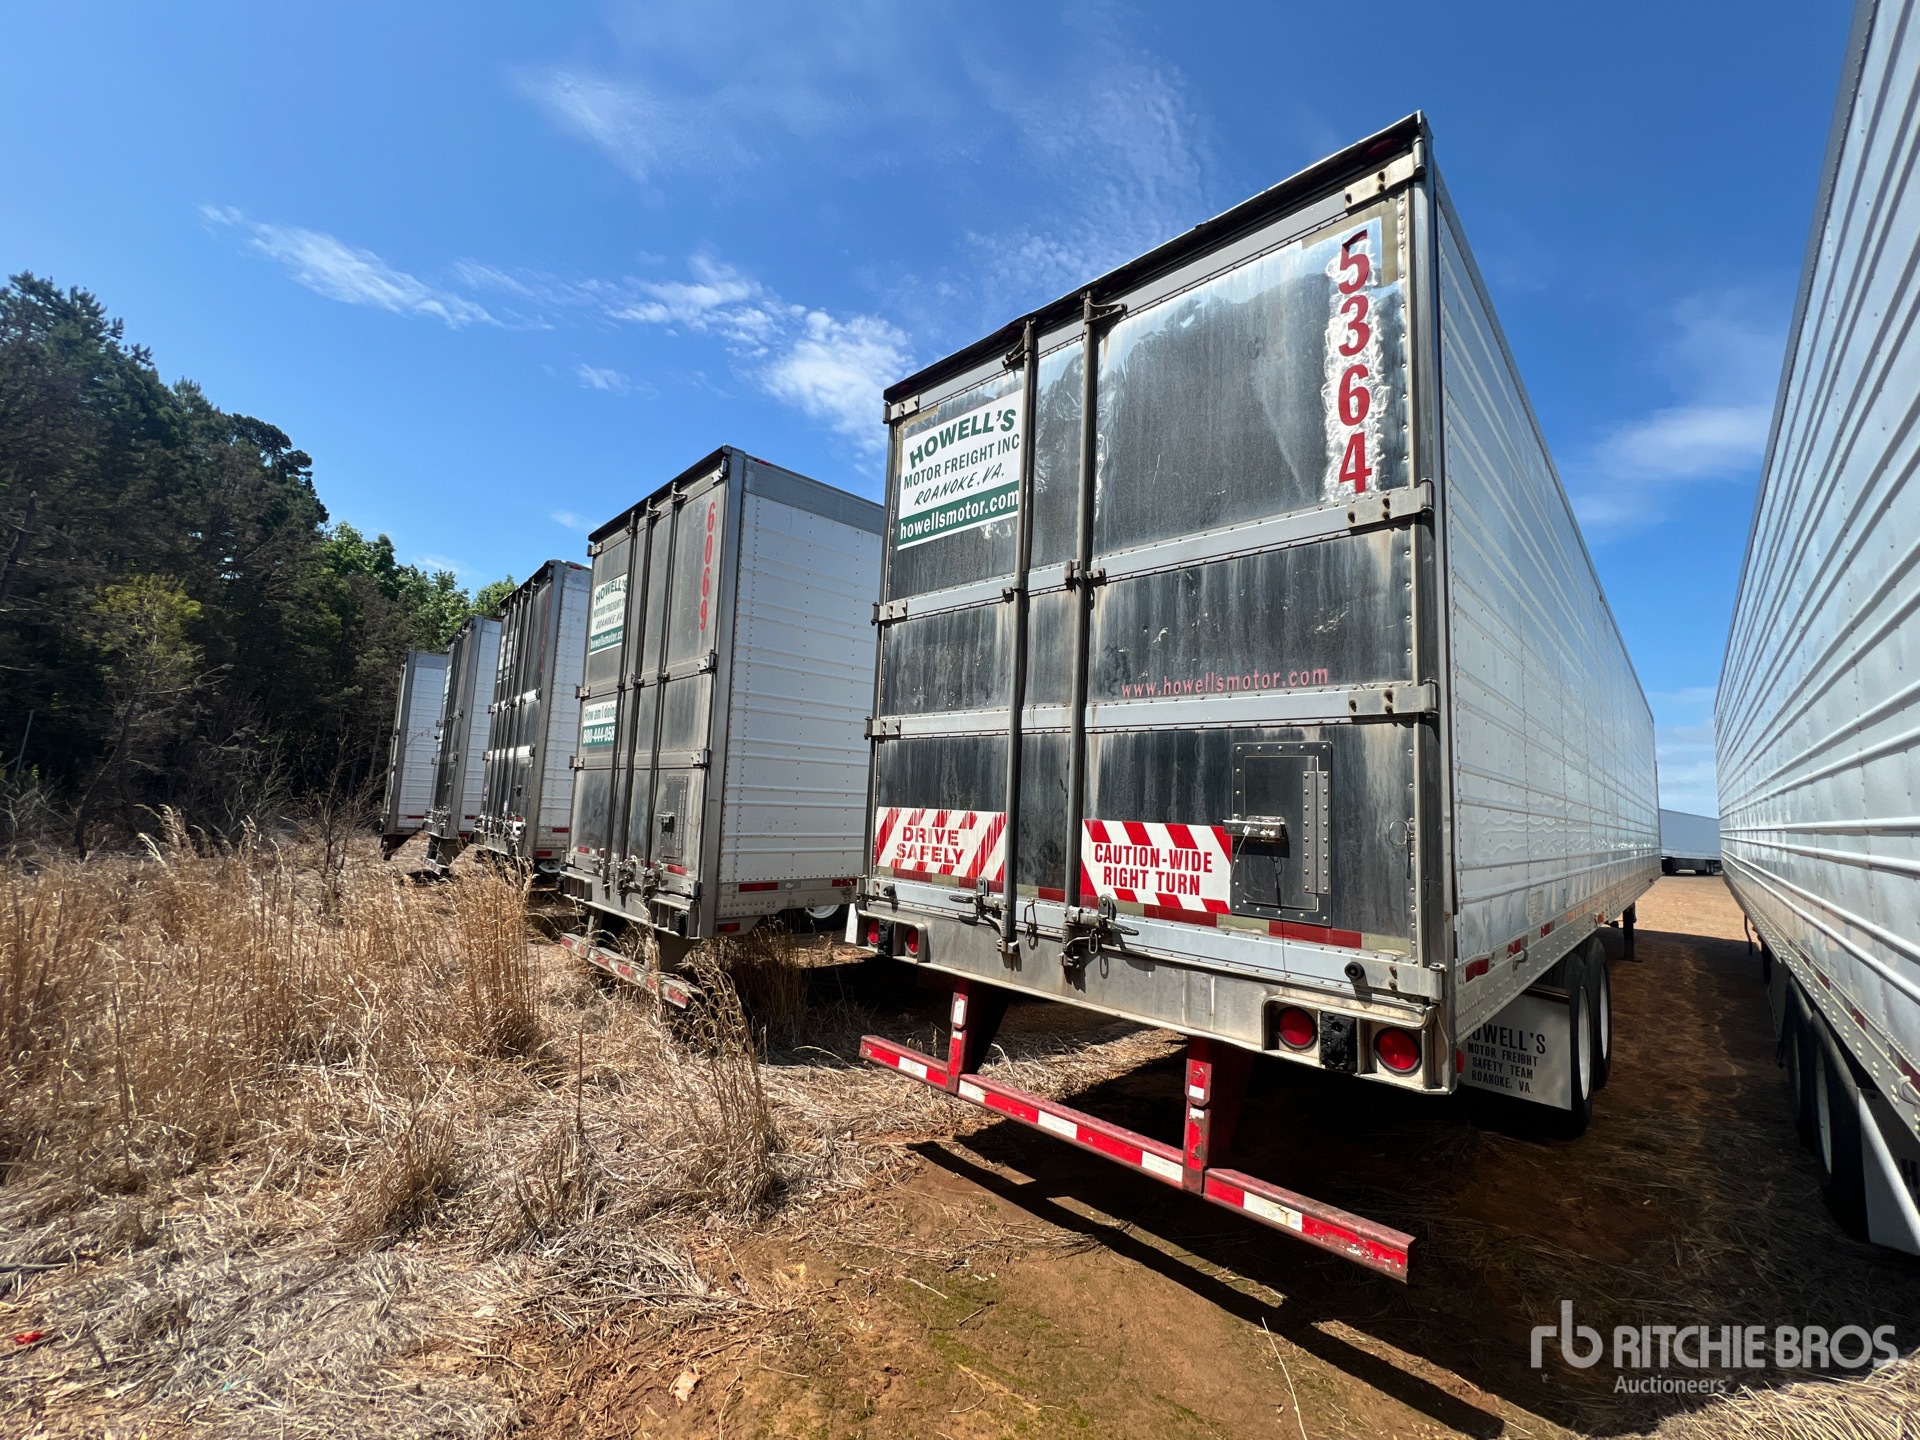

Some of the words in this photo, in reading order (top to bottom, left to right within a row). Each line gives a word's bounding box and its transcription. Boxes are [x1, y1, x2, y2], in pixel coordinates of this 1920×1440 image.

[1338, 229, 1372, 494] 5364
[909, 409, 1016, 470] HOWELL'S
[904, 463, 941, 490] MOTOR
[944, 443, 995, 475] FREIGHT
[997, 433, 1020, 455] INC
[900, 489, 1019, 540] howellsmotor.com
[700, 502, 716, 631] 6069
[1121, 668, 1329, 698] www.howellsmotor.com
[902, 826, 959, 846] DRIVE
[896, 842, 965, 865] SAFELY
[1094, 843, 1213, 873] CAUTION-WIDE
[1103, 865, 1149, 890] RIGHT
[1155, 871, 1200, 896] TURN
[1467, 1023, 1546, 1054] OWELL'S
[1467, 1042, 1496, 1058] MOTOR
[1502, 1049, 1538, 1067] FREIGHT
[1472, 1056, 1503, 1073] SAFETY
[1510, 1065, 1533, 1080] TEAM
